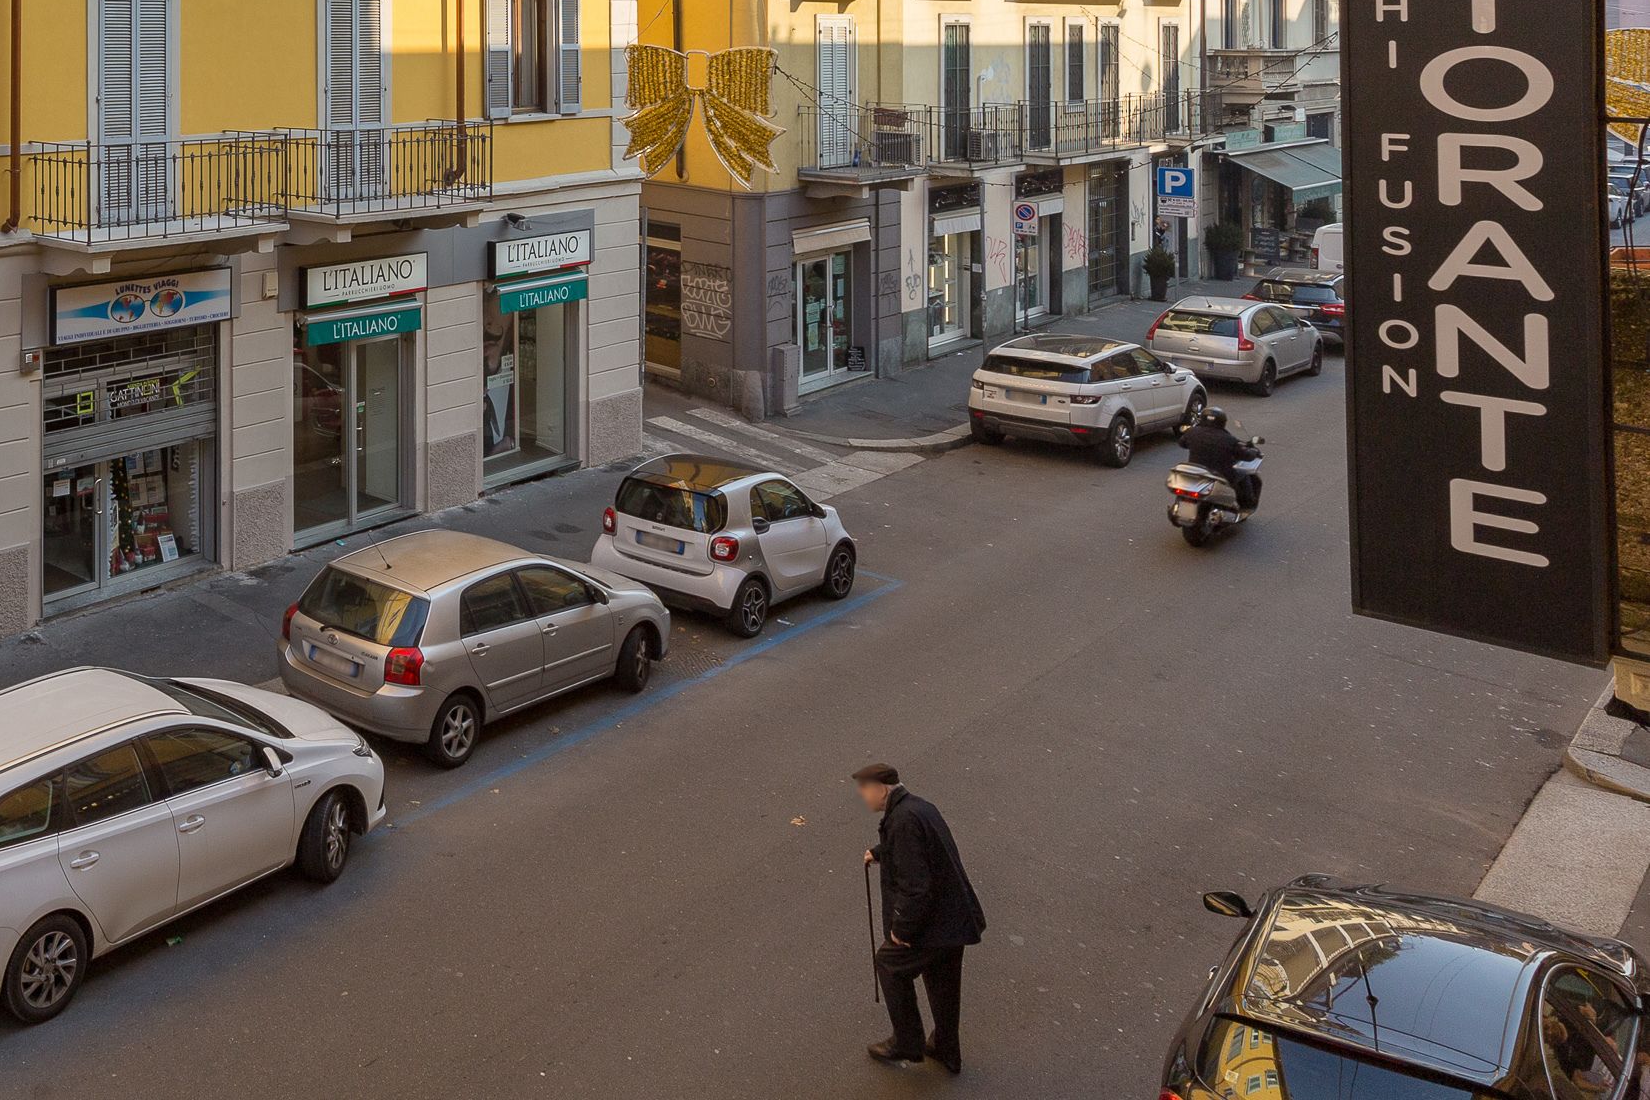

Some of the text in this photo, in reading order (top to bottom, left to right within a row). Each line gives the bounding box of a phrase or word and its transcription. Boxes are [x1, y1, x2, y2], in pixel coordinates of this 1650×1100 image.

[1165, 170, 1187, 194] P
[507, 236, 579, 263] L'ITALIANO
[323, 259, 413, 292] L'ITALIANO
[1378, 132, 1419, 398] FUSION
[115, 283, 151, 296] LUNETTES
[341, 283, 396, 297] PARRUCCHIERI UOMO
[519, 286, 569, 308] L'ITALIANO
[333, 315, 398, 339] L'ITALIANO
